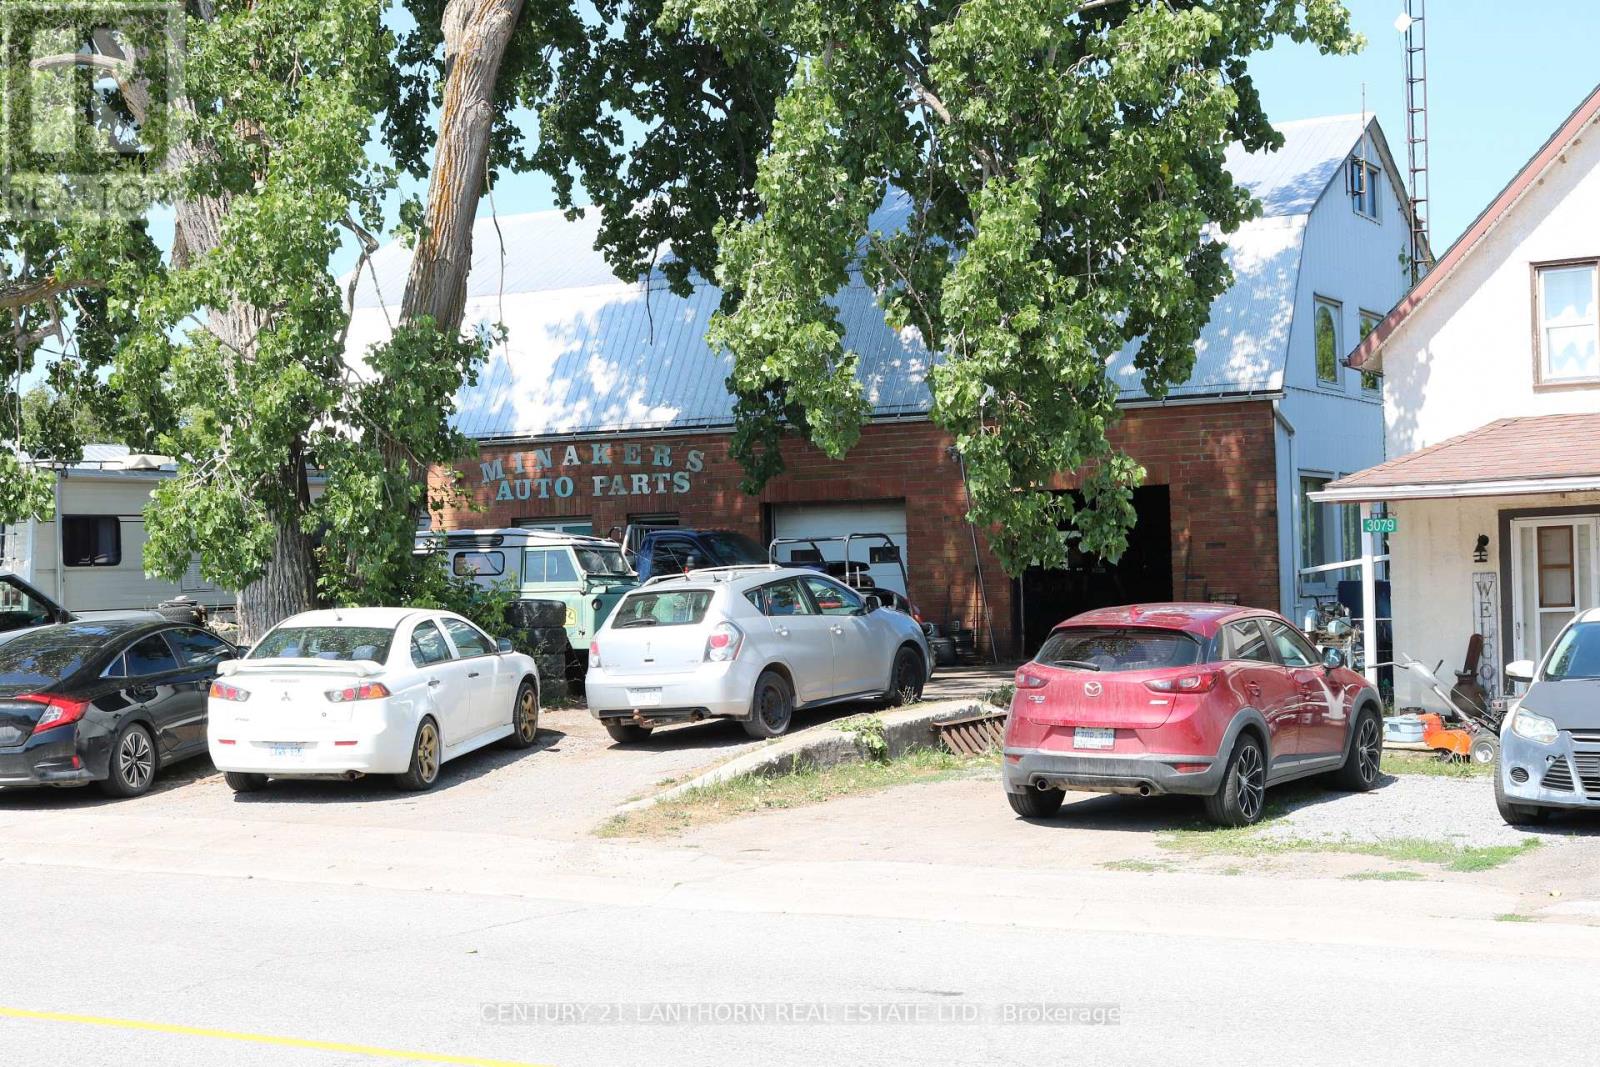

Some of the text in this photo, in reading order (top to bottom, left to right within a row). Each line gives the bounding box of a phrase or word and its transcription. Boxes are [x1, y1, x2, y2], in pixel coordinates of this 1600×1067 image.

[496, 471, 691, 500] AUTO PARTS
[1367, 519, 1394, 532] 3079
